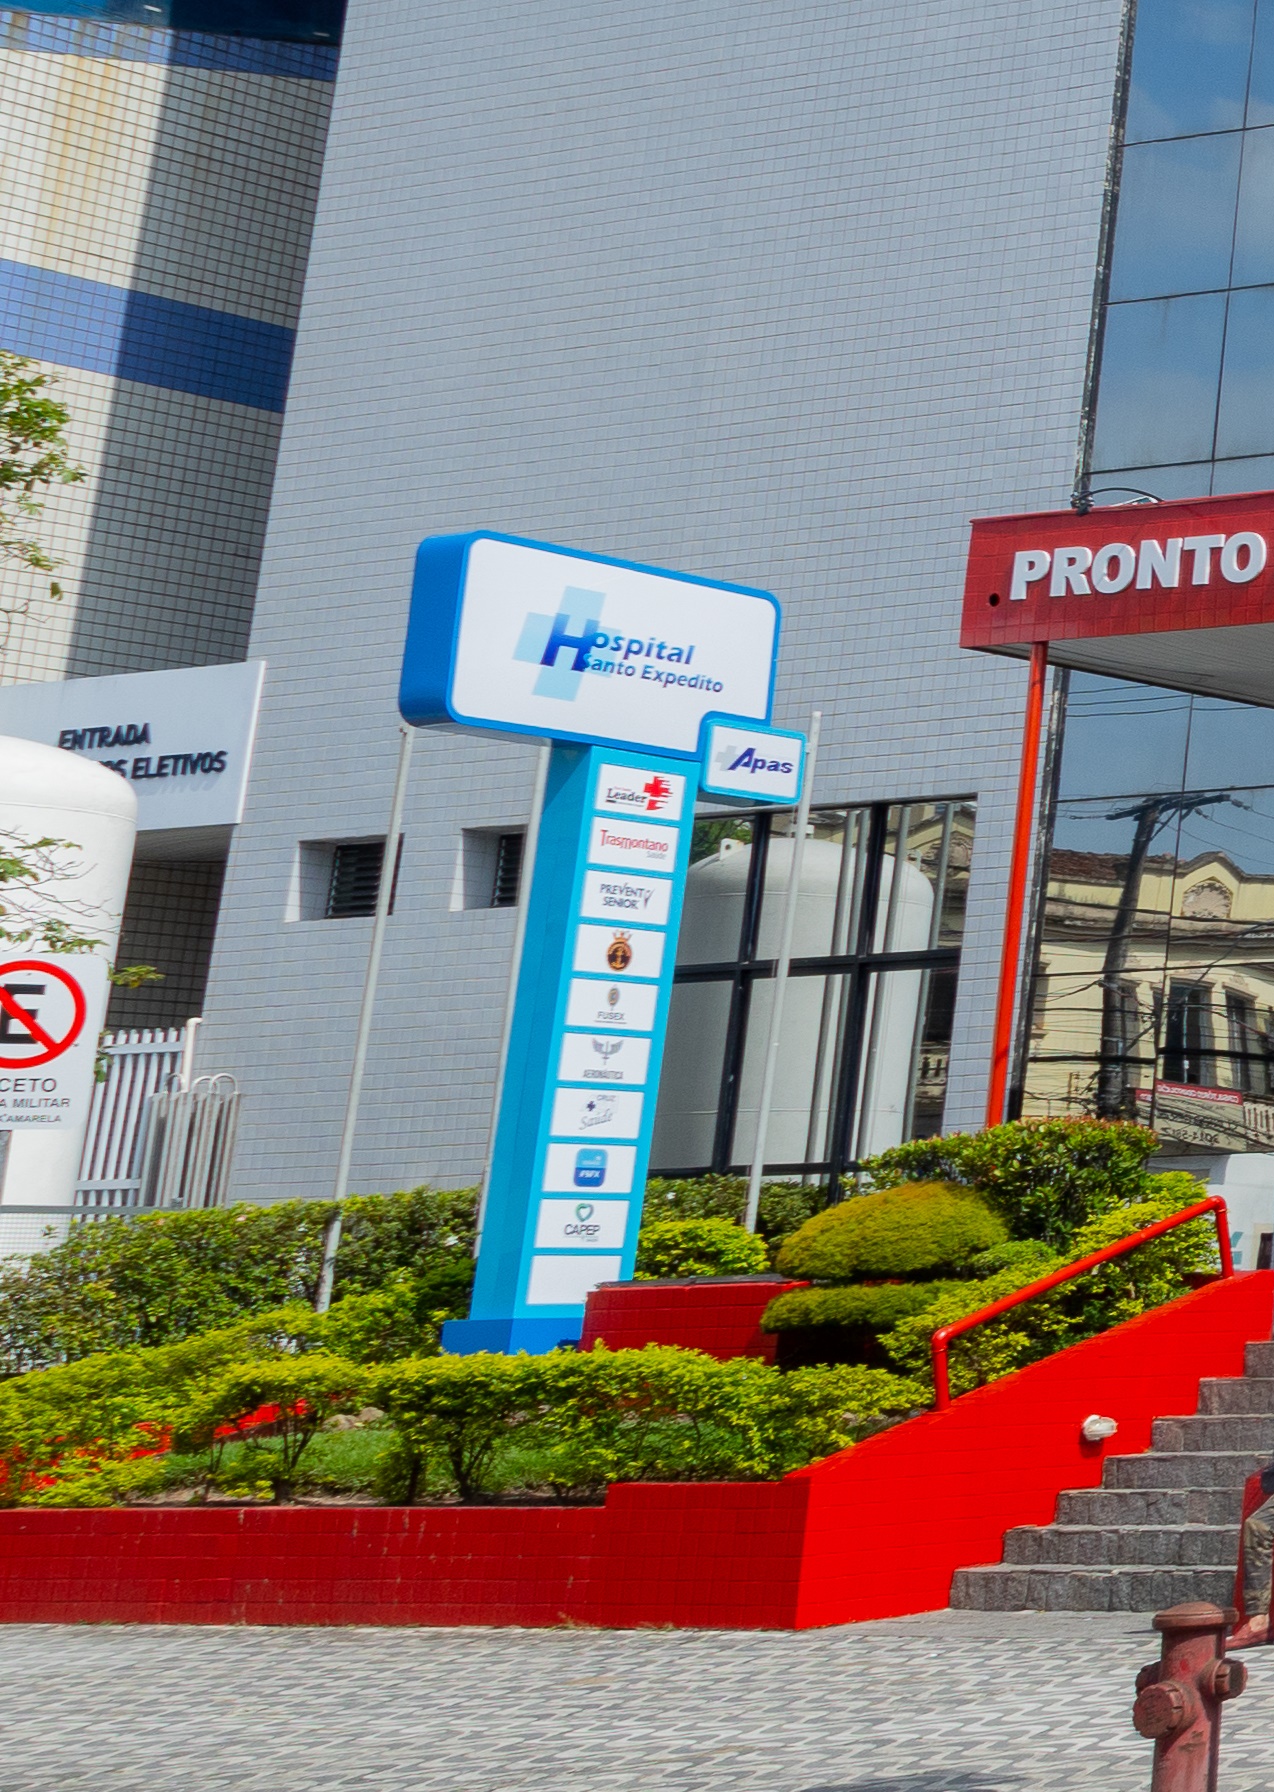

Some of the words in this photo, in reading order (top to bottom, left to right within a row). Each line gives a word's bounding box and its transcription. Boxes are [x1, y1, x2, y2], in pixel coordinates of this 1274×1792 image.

[1009, 531, 1268, 601] PRONTO
[540, 613, 695, 672] Hospital
[582, 653, 636, 677] Santo
[640, 665, 724, 693] Expedito
[57, 722, 151, 751] ENTRADA
[130, 750, 228, 779] ELETIVOS
[727, 747, 794, 774] Apas
[606, 788, 647, 803] Leader
[600, 829, 669, 852] Trasmontano
[600, 882, 641, 898] PREVENT
[602, 896, 640, 909] SENIOR
[0, 984, 46, 1044] E
[597, 1010, 625, 1021] FUSEX
[12, 1097, 71, 1109] MILITAR
[564, 1223, 600, 1236] CAPEP
